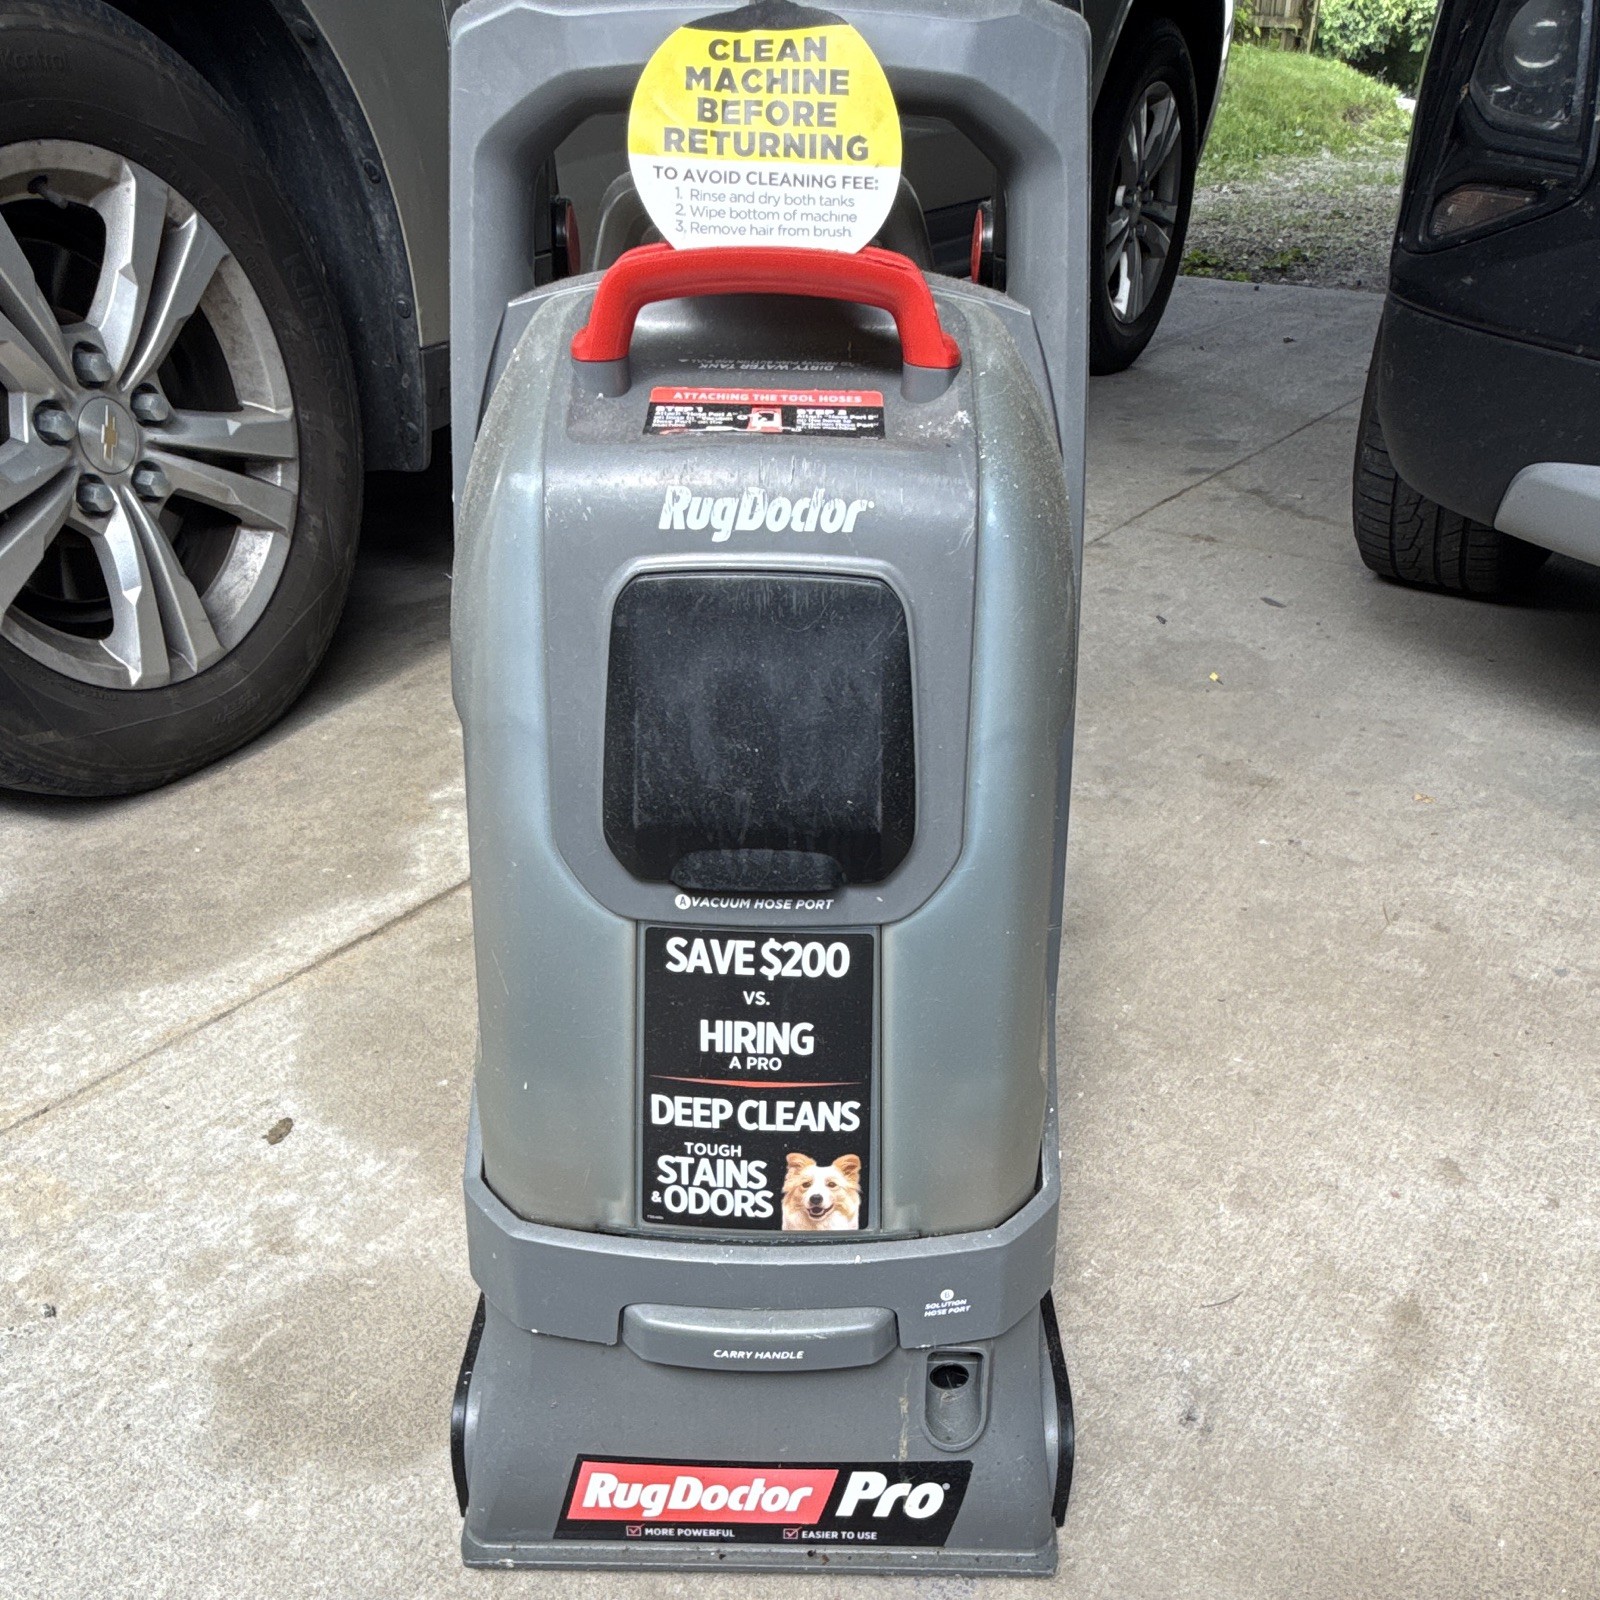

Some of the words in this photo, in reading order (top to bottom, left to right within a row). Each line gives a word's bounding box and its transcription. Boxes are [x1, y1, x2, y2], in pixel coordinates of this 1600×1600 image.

[708, 36, 827, 62] CLEAN
[685, 66, 849, 96] MACHINE
[697, 97, 837, 128] BEFORE
[663, 127, 869, 161] RETURNING
[653, 165, 678, 180] TO
[683, 169, 741, 184] AVOID
[746, 171, 837, 189] CLEANING
[842, 175, 879, 190] FEE:
[675, 187, 683, 200] 1.
[690, 188, 726, 202] Rinse
[729, 189, 755, 204] and
[758, 190, 780, 207] dry
[784, 191, 816, 206] both
[819, 193, 855, 207] tanks
[675, 203, 686, 216] 2.
[690, 205, 726, 220] Wipe
[729, 207, 780, 221] bottom
[783, 208, 798, 221] of
[801, 210, 857, 223] machine
[690, 221, 747, 236] Remove
[750, 223, 775, 236] hair
[777, 224, 810, 237] from
[813, 225, 852, 237] brush
[673, 392, 750, 401] ATTACHING
[753, 393, 778, 402] THE
[781, 394, 815, 402] TOOL
[818, 395, 862, 404] HOSES
[658, 485, 868, 543] RugDoctor
[691, 896, 751, 909] VACUUM
[753, 898, 793, 910] HOSE
[795, 898, 834, 910] PORT
[665, 936, 755, 976] SAVE
[759, 937, 850, 981] $200
[743, 990, 771, 1006] VS.
[700, 1019, 815, 1056] HIRING
[728, 1056, 742, 1069] A
[746, 1057, 782, 1071] PRO
[651, 1093, 733, 1130] DEEP
[737, 1100, 861, 1132] CLEANS
[684, 1141, 742, 1157] TOUGH
[657, 1154, 768, 1190] STAINS
[651, 1190, 662, 1203] &
[664, 1184, 774, 1218] ODORS
[924, 1299, 967, 1310] SOLUTION
[924, 1308, 947, 1317] HOSE
[948, 1305, 971, 1314] PORT
[713, 1349, 753, 1360] CARRY
[754, 1350, 805, 1360] HANDLE
[582, 1471, 814, 1518] RugDoctor
[835, 1470, 946, 1520] Pro
[644, 1527, 675, 1537] MORE
[677, 1528, 735, 1538] POWERFUL
[801, 1530, 838, 1540] EASIER
[841, 1531, 855, 1540] TO
[857, 1531, 878, 1540] USE
